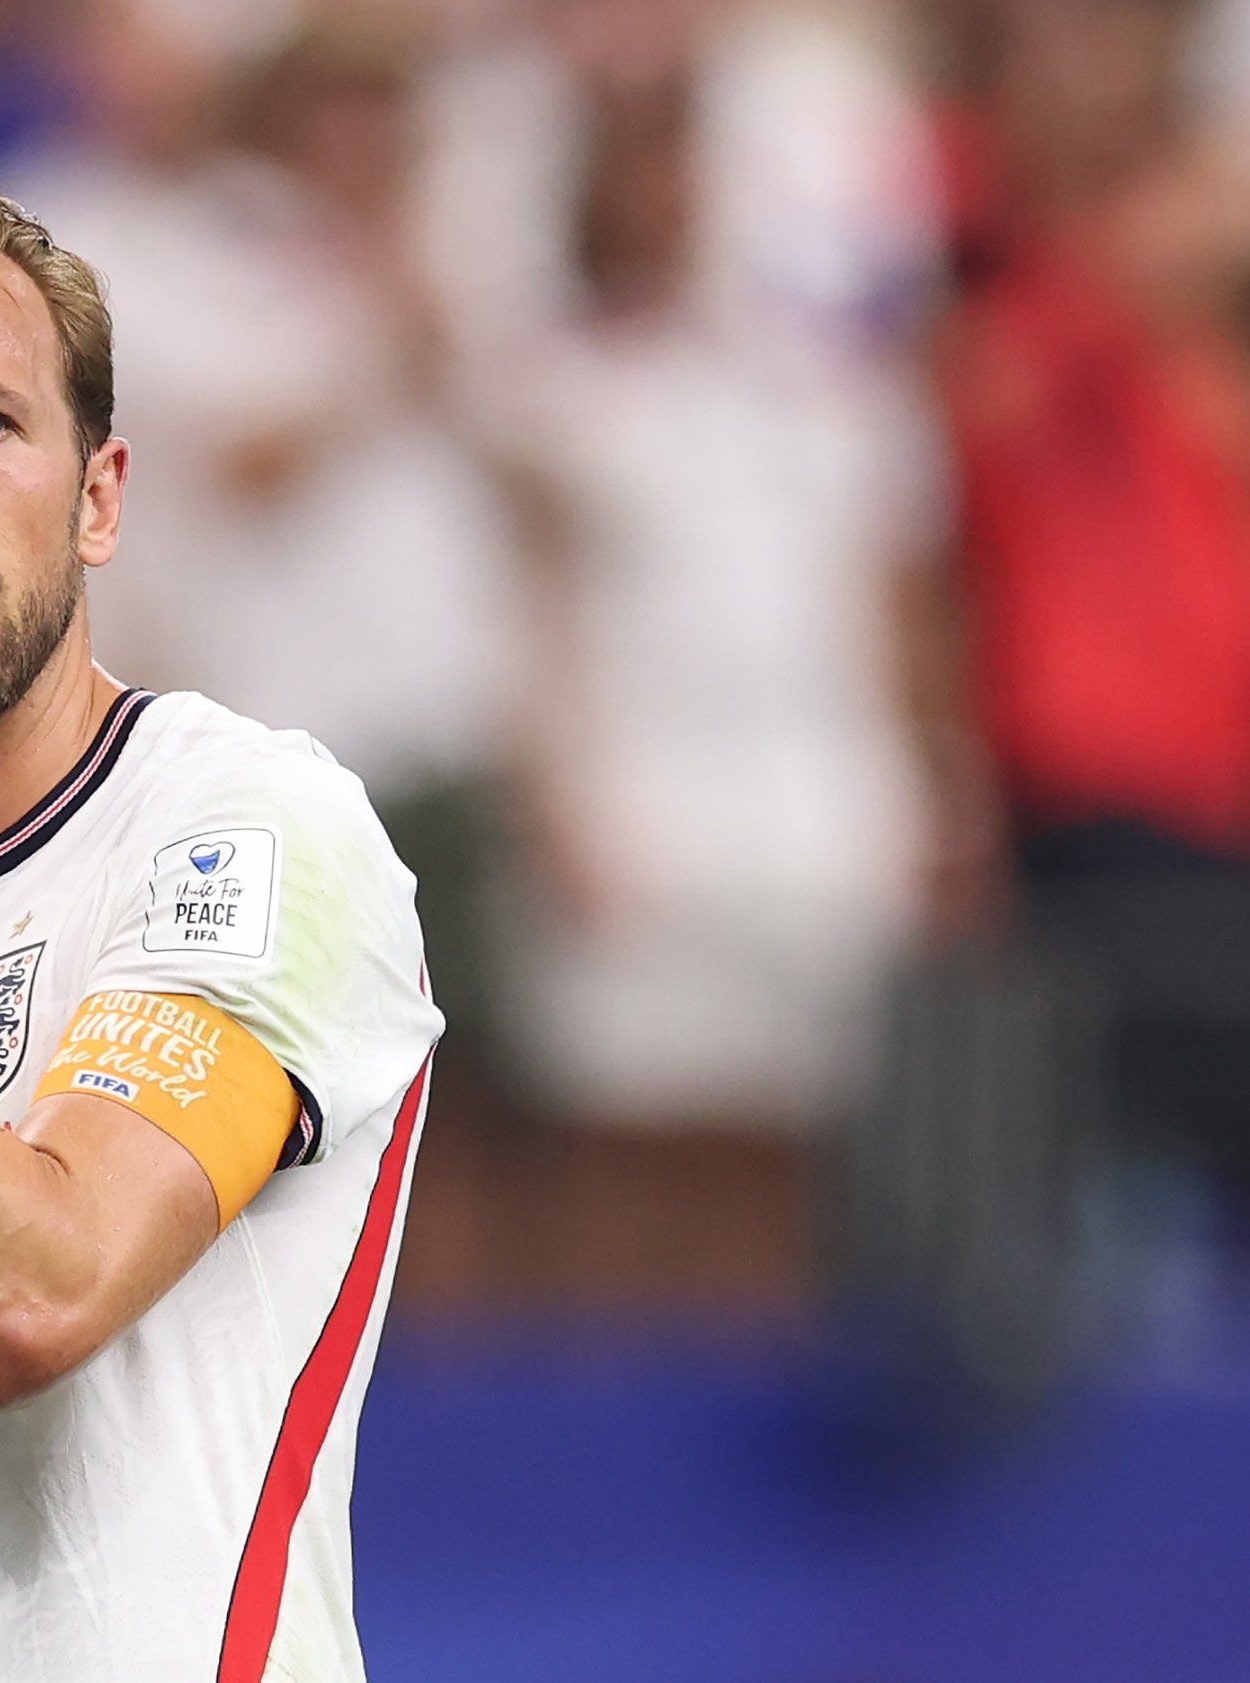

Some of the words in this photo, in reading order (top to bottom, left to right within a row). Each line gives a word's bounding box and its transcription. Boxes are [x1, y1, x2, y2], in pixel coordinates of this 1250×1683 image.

[219, 878, 244, 900] For
[174, 903, 238, 927] PEACE
[184, 930, 218, 941] FIFA
[88, 990, 222, 1055] FOOTBALL
[69, 1012, 216, 1081] UNITES
[78, 1074, 131, 1098] FIFA
[96, 1045, 207, 1109] World
